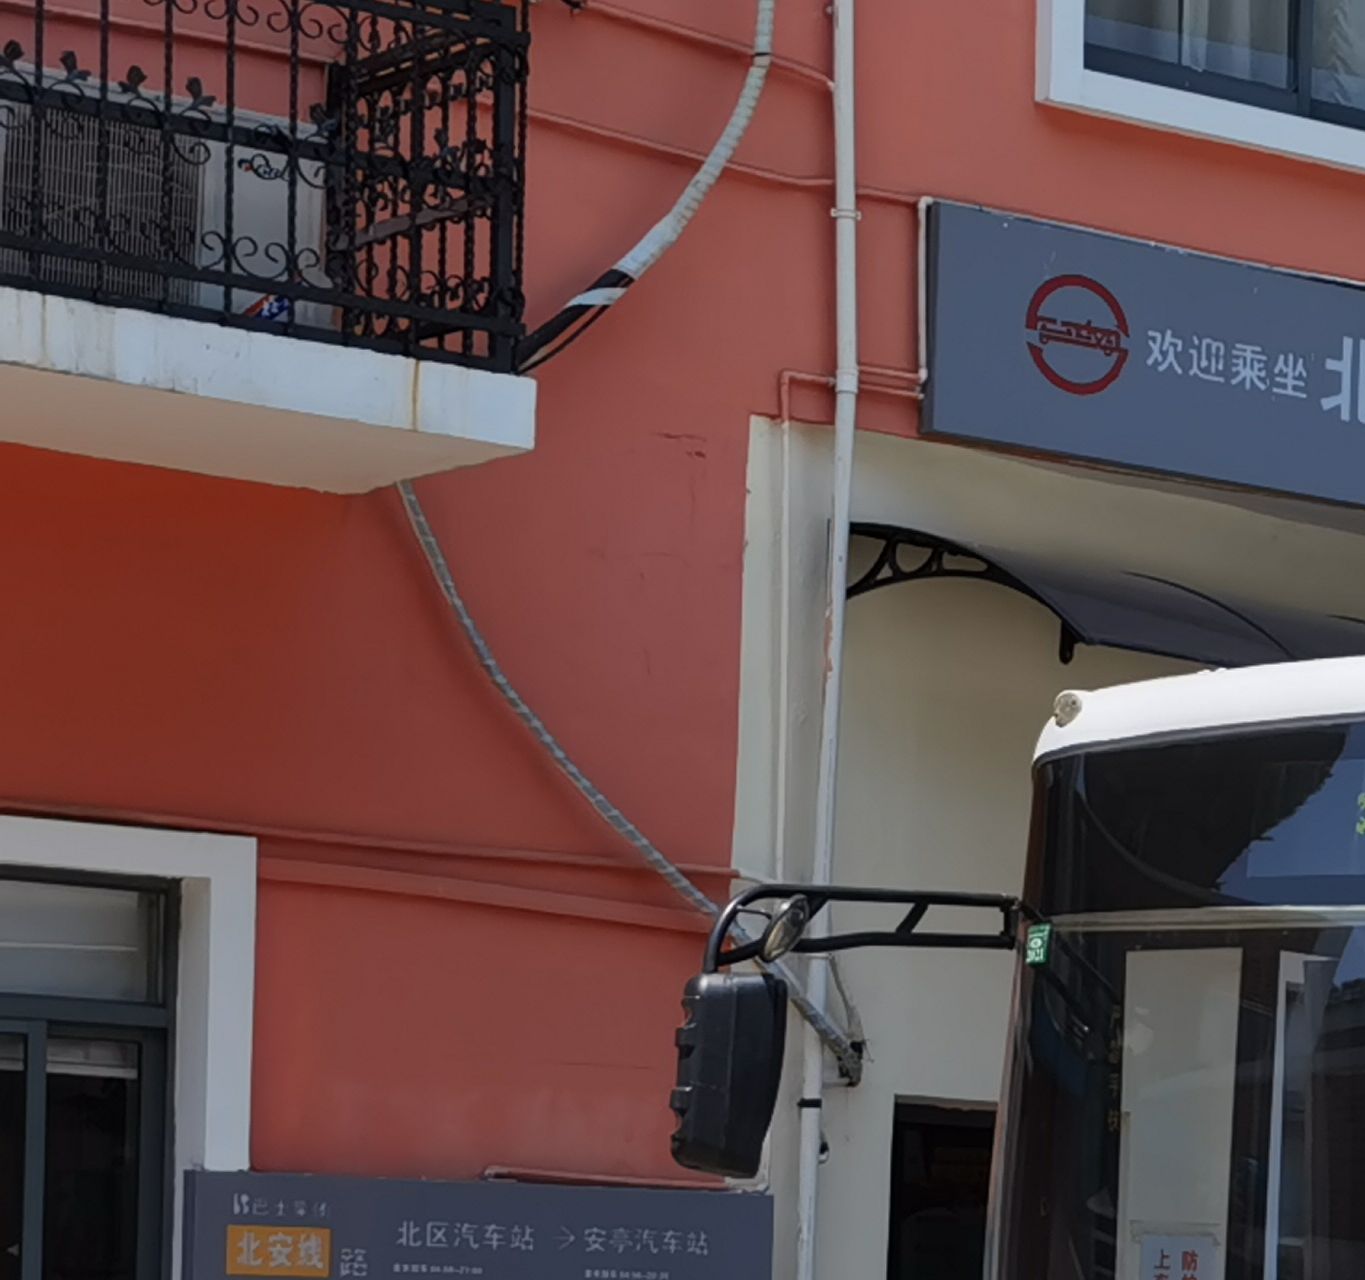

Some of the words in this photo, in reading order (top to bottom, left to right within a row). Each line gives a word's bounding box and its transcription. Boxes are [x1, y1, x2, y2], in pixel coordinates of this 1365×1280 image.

[1146, 329, 1307, 398] 欢迎乘坐
[236, 1231, 325, 1270] 北安线
[396, 1221, 535, 1251] 北区汽车站
[584, 1227, 709, 1256] 安亭汽车站
